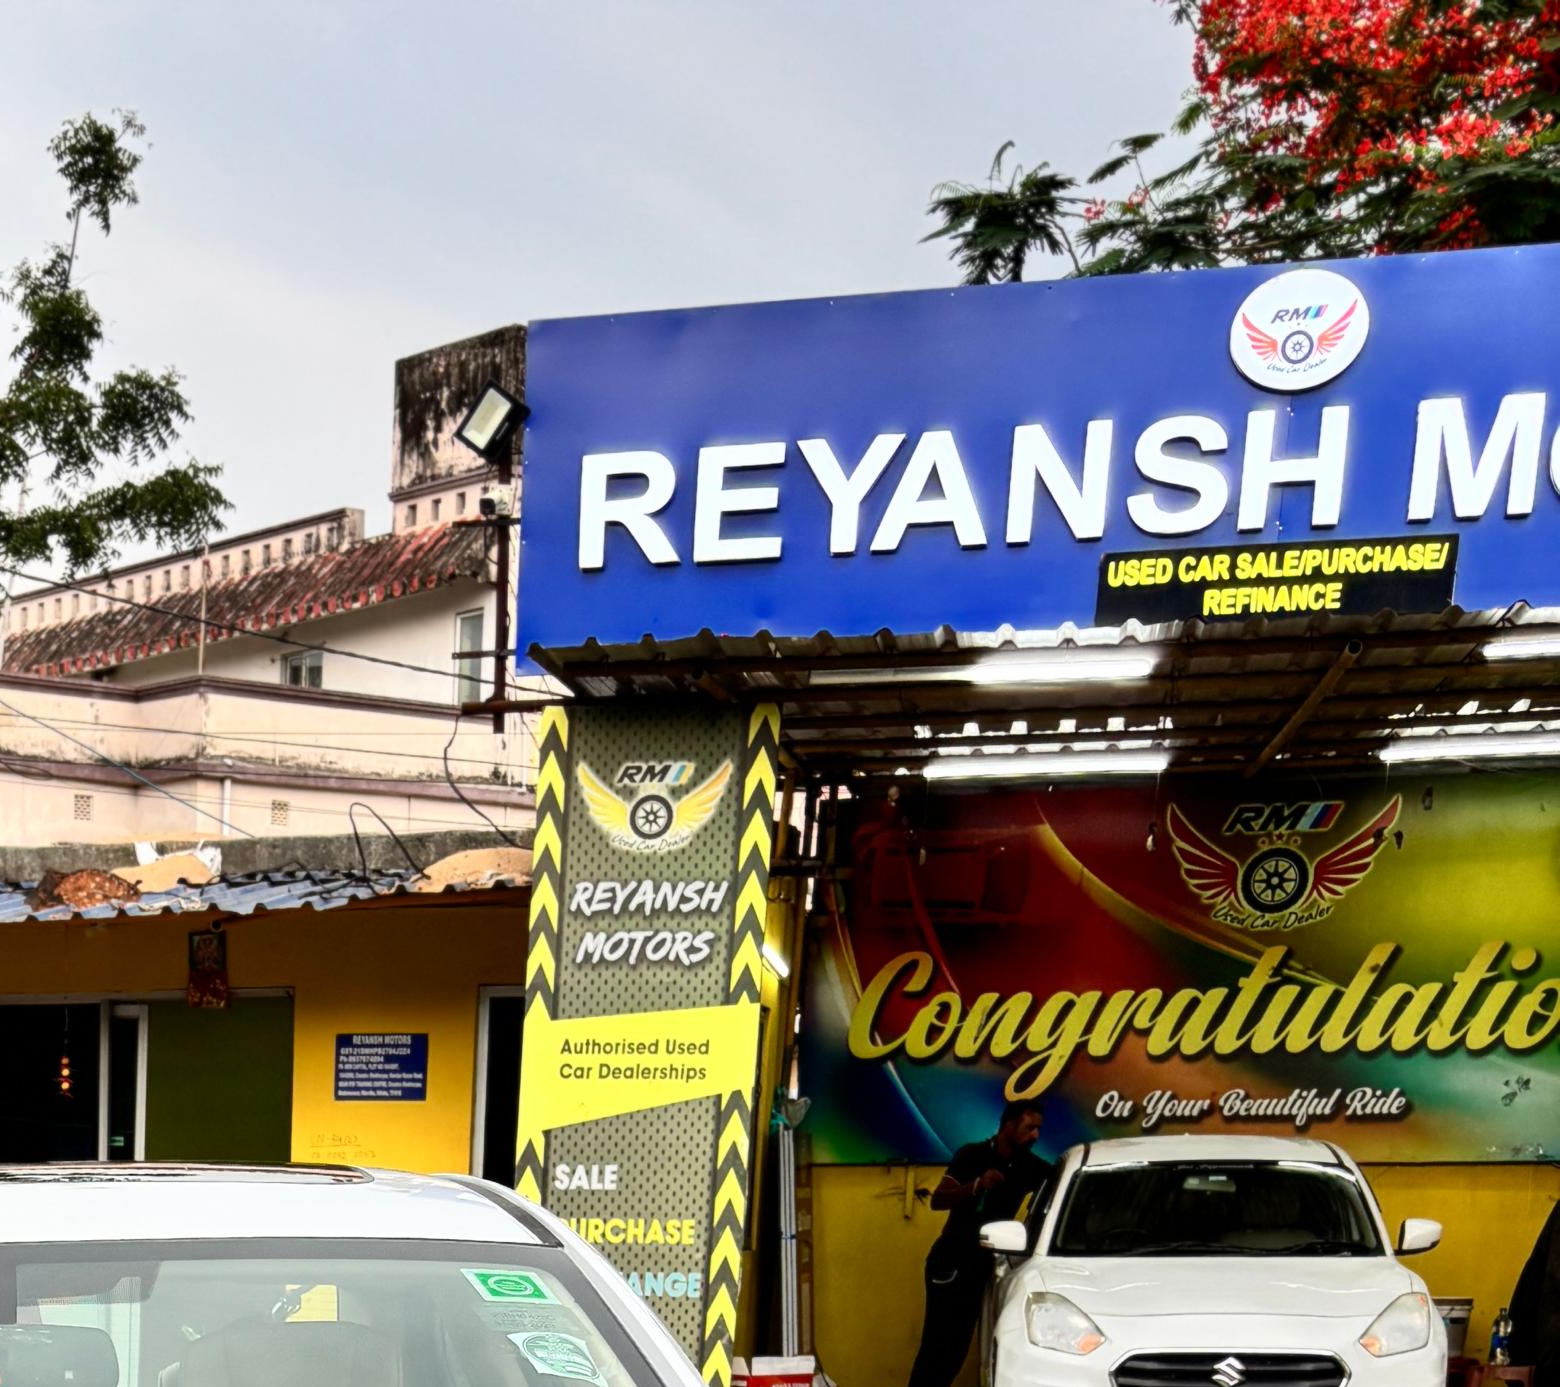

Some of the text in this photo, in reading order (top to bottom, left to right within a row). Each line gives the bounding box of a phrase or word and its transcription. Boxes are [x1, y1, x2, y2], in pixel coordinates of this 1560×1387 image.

[576, 391, 1560, 571] REYANSH M
[1107, 557, 1174, 588] USED
[1177, 553, 1230, 583] CAR
[1202, 582, 1343, 617] REFINANCE
[636, 840, 656, 851] Car
[569, 879, 729, 917] REYANSH
[1211, 904, 1333, 929] Used Car Dealer
[574, 930, 716, 967] MOTORS
[559, 1038, 711, 1056] Authorised Used
[559, 1062, 707, 1084] Car Dealerships
[1095, 1087, 1407, 1128] On Your Beautiful Ride
[553, 1163, 619, 1191] SALE
